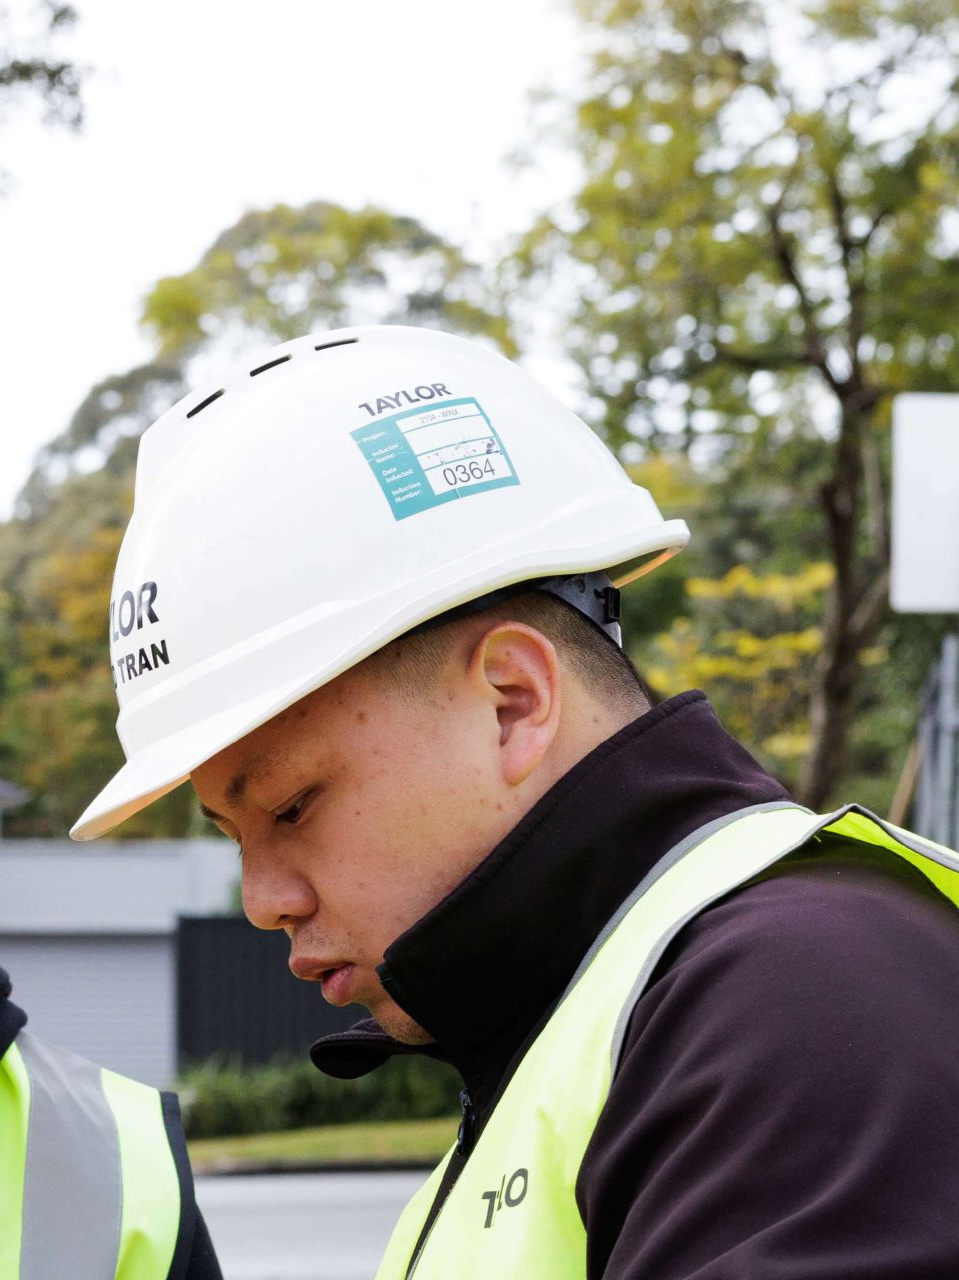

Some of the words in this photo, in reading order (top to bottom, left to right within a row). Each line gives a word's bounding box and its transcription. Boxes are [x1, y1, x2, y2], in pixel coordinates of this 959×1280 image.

[358, 382, 452, 417] TAYLOR
[382, 466, 398, 477] Date
[443, 458, 495, 486] 0364
[391, 481, 422, 497] Induction
[117, 639, 170, 684] TRAN
